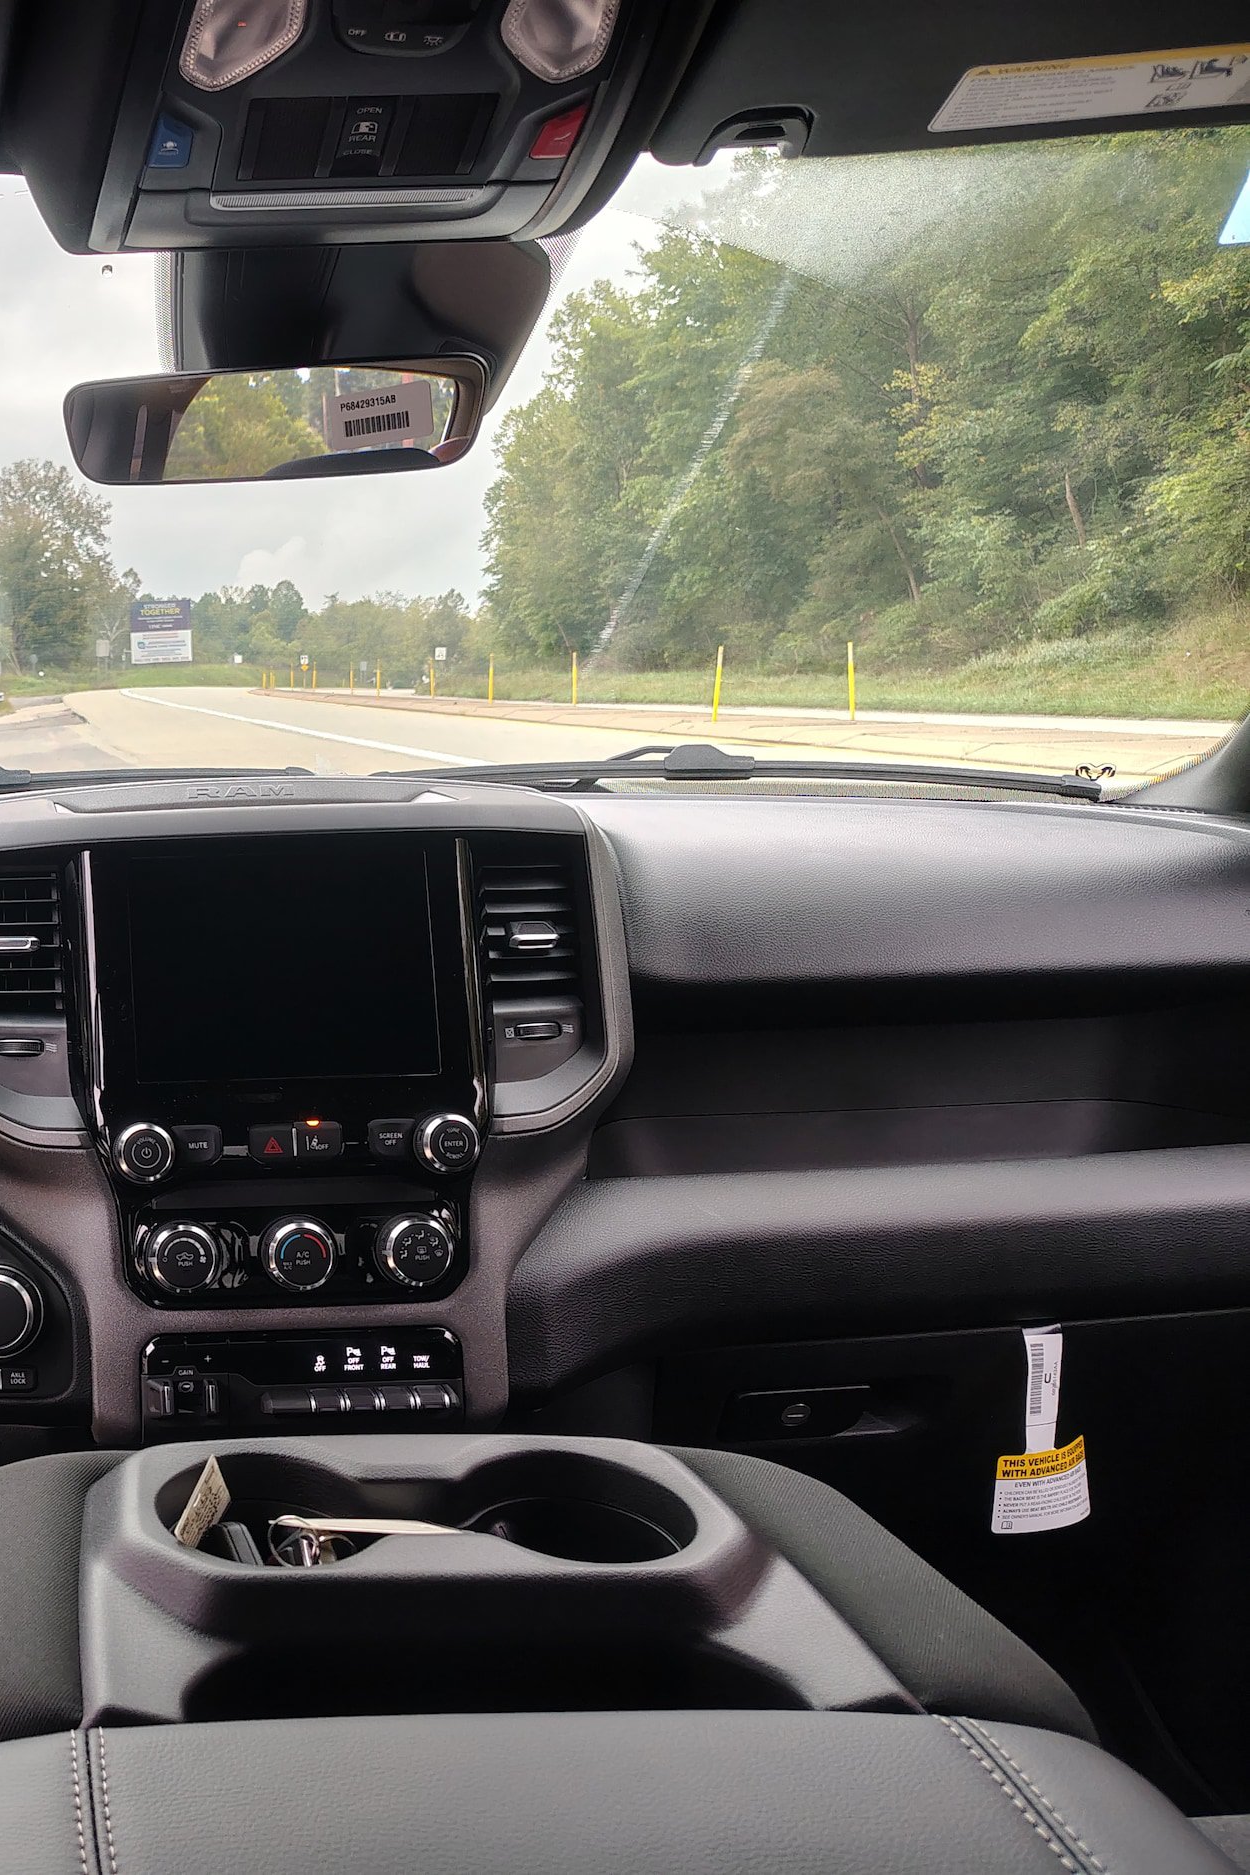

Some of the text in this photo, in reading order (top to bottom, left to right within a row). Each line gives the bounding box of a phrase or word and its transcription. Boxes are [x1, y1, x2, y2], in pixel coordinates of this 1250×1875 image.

[340, 394, 397, 412] P68429315AB
[140, 607, 180, 616] TOGETHER
[187, 784, 295, 799] RAM
[136, 1136, 157, 1145] VOLUME
[188, 1141, 209, 1149] MUTE
[317, 1143, 330, 1151] OFF
[296, 1250, 310, 1258] A/C
[413, 1361, 431, 1369] HAUL
[1003, 1459, 1026, 1468] THIS
[1028, 1453, 1060, 1467] VEHICLE
[1002, 1469, 1027, 1477] WITH
[1029, 1462, 1068, 1477] ADVANCED
[1032, 1479, 1045, 1487] WITH
